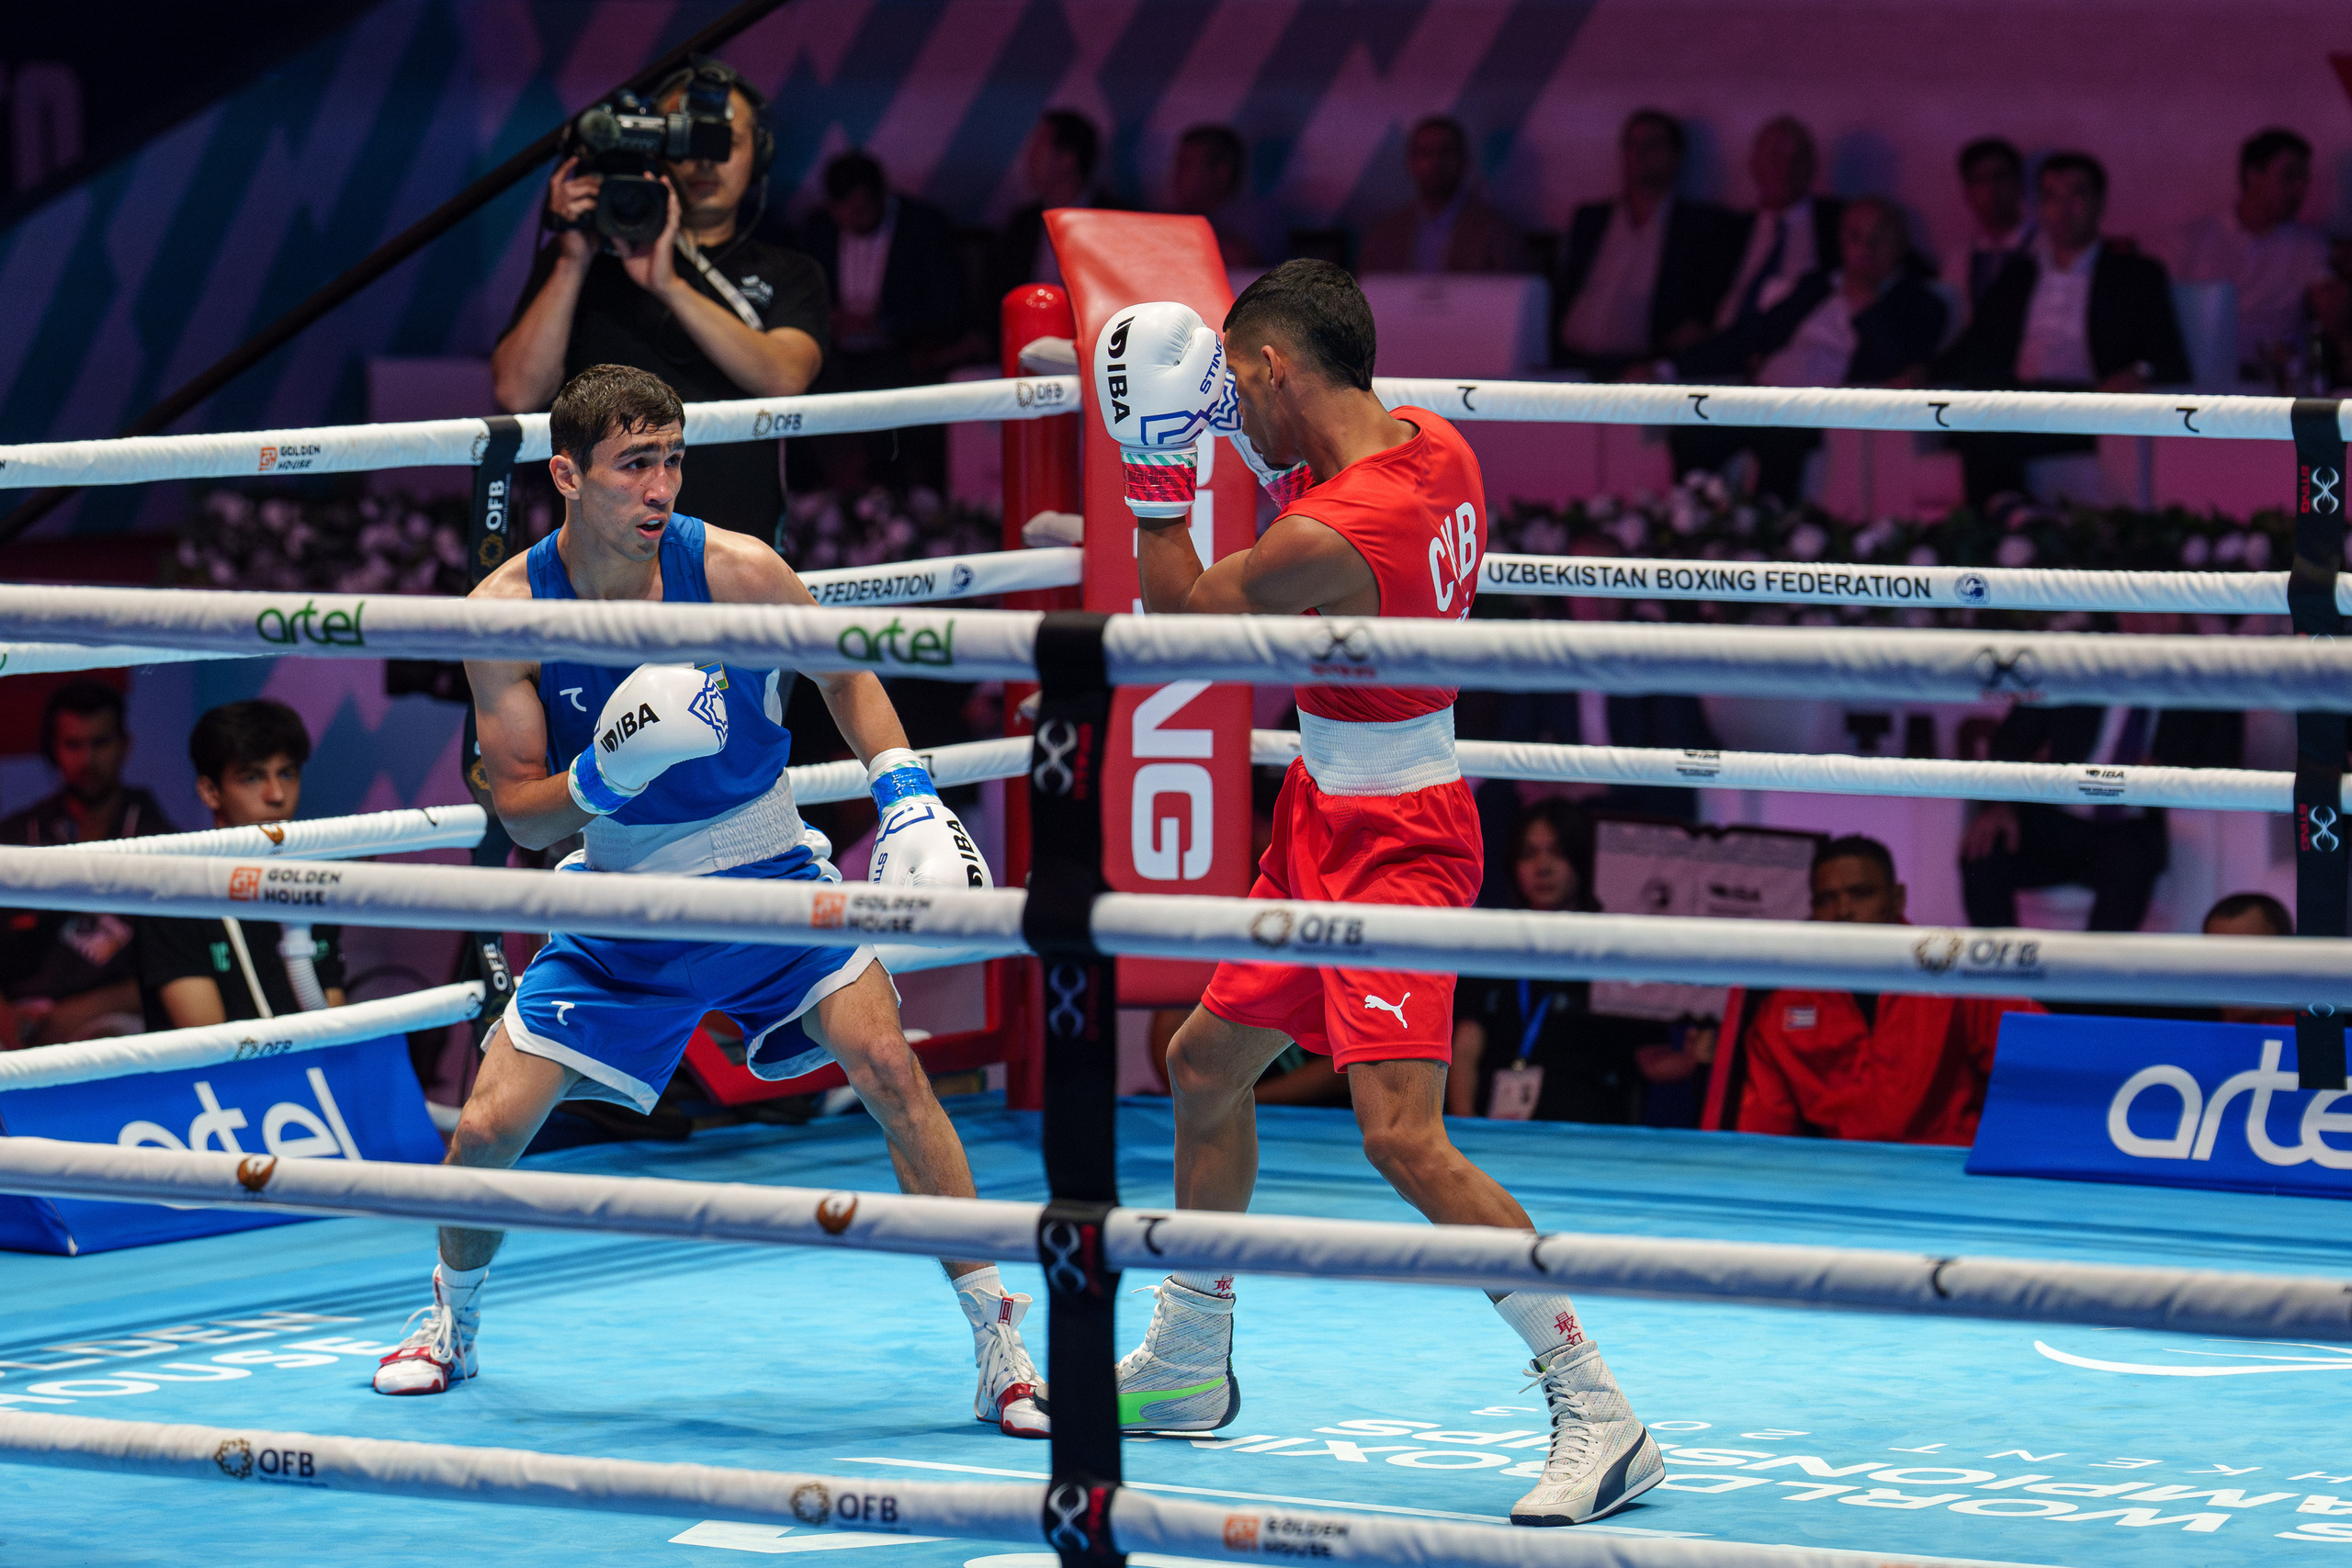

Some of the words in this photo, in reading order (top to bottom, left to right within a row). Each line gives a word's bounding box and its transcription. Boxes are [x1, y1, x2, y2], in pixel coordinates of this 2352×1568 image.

[1107, 364, 1130, 424] IBA
[485, 479, 505, 531] OFB
[825, 572, 935, 604] FEDERATION
[1487, 561, 1648, 589] UZBEKISTAN
[1657, 569, 1756, 592] BOXING
[1765, 570, 1932, 599] FEDERATION
[255, 600, 366, 645] artel
[838, 618, 956, 666] artel
[616, 703, 661, 744] IBA
[946, 820, 978, 862] IBA
[263, 888, 324, 906] HOUSE
[266, 868, 343, 885] GOLDEN
[483, 942, 508, 991] OFB
[258, 1449, 315, 1477] OFB
[837, 1492, 898, 1522] OFB
